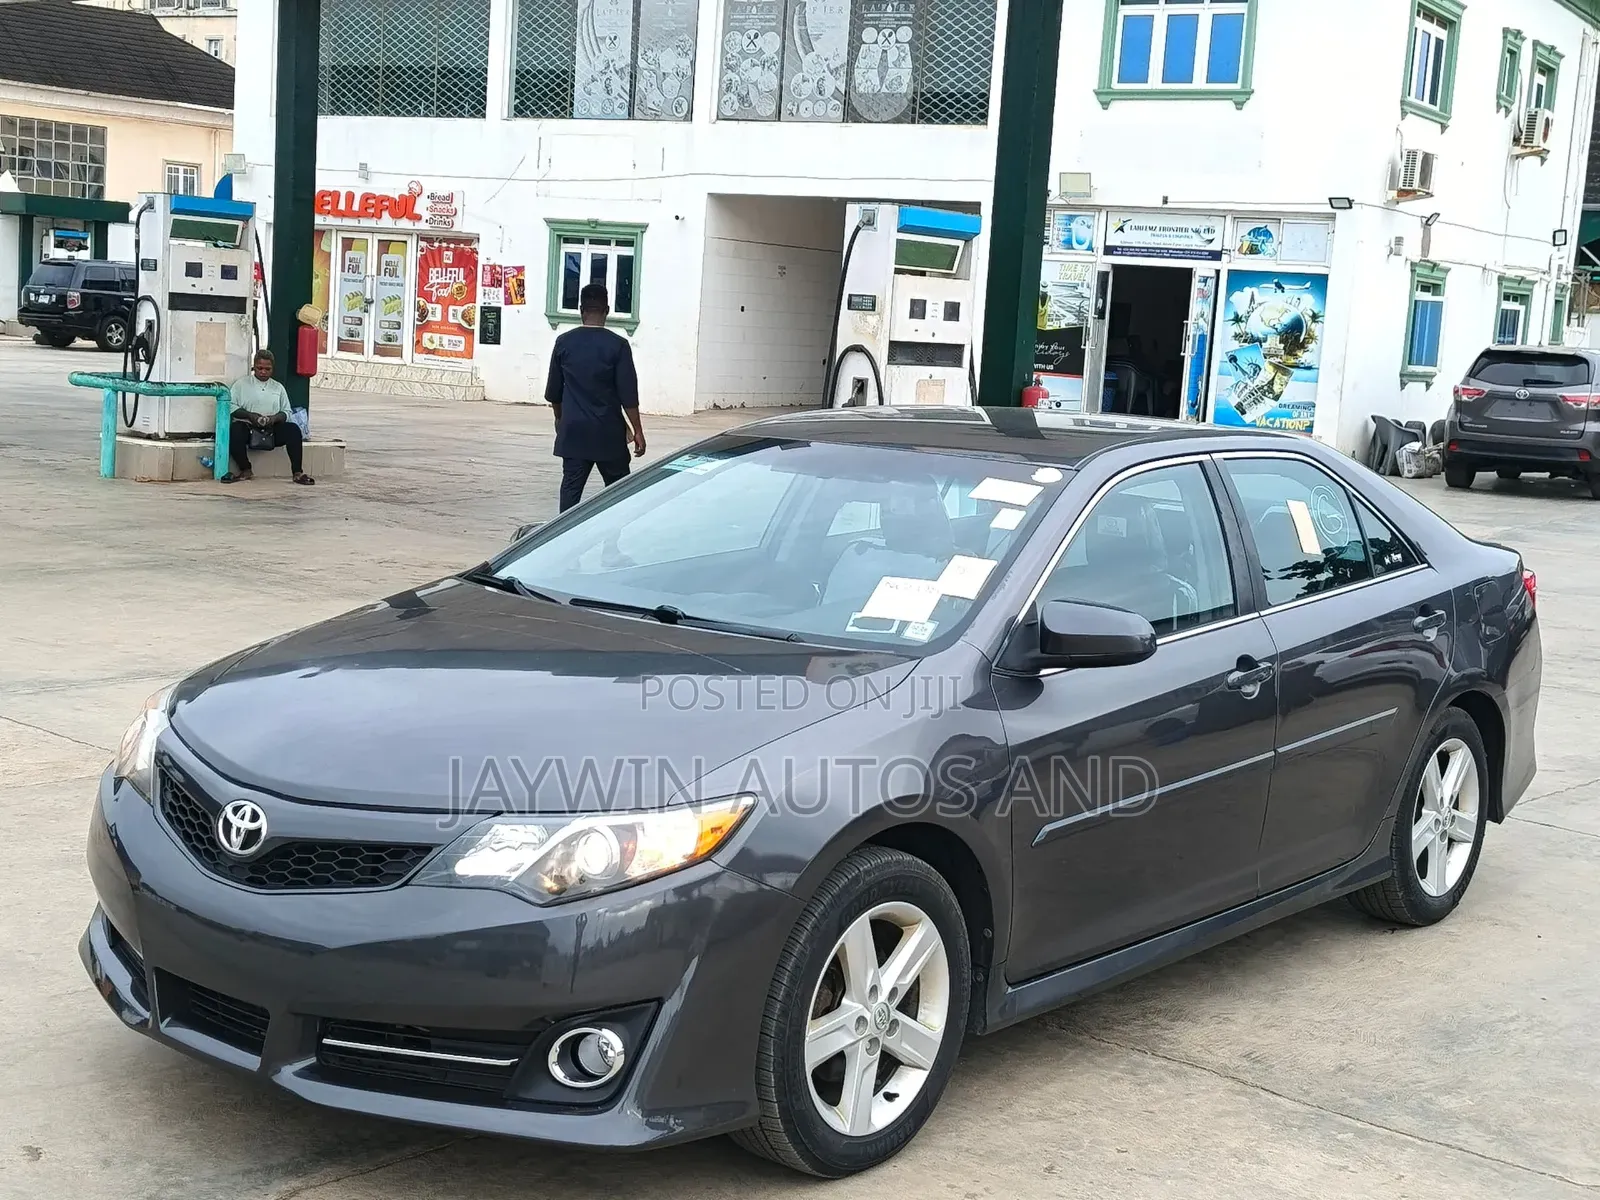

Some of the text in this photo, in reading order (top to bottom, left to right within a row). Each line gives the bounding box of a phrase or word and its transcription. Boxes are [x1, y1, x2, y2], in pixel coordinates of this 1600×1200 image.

[429, 192, 450, 202] Bread
[315, 189, 422, 221] ELLEFUL
[428, 206, 454, 215] Snacks
[322, 217, 416, 227] DIBLES
[428, 218, 451, 227] Drinks
[1059, 263, 1090, 273] TIME TO
[1058, 272, 1087, 282] TRAVEL
[1278, 403, 1312, 411] DREAMING
